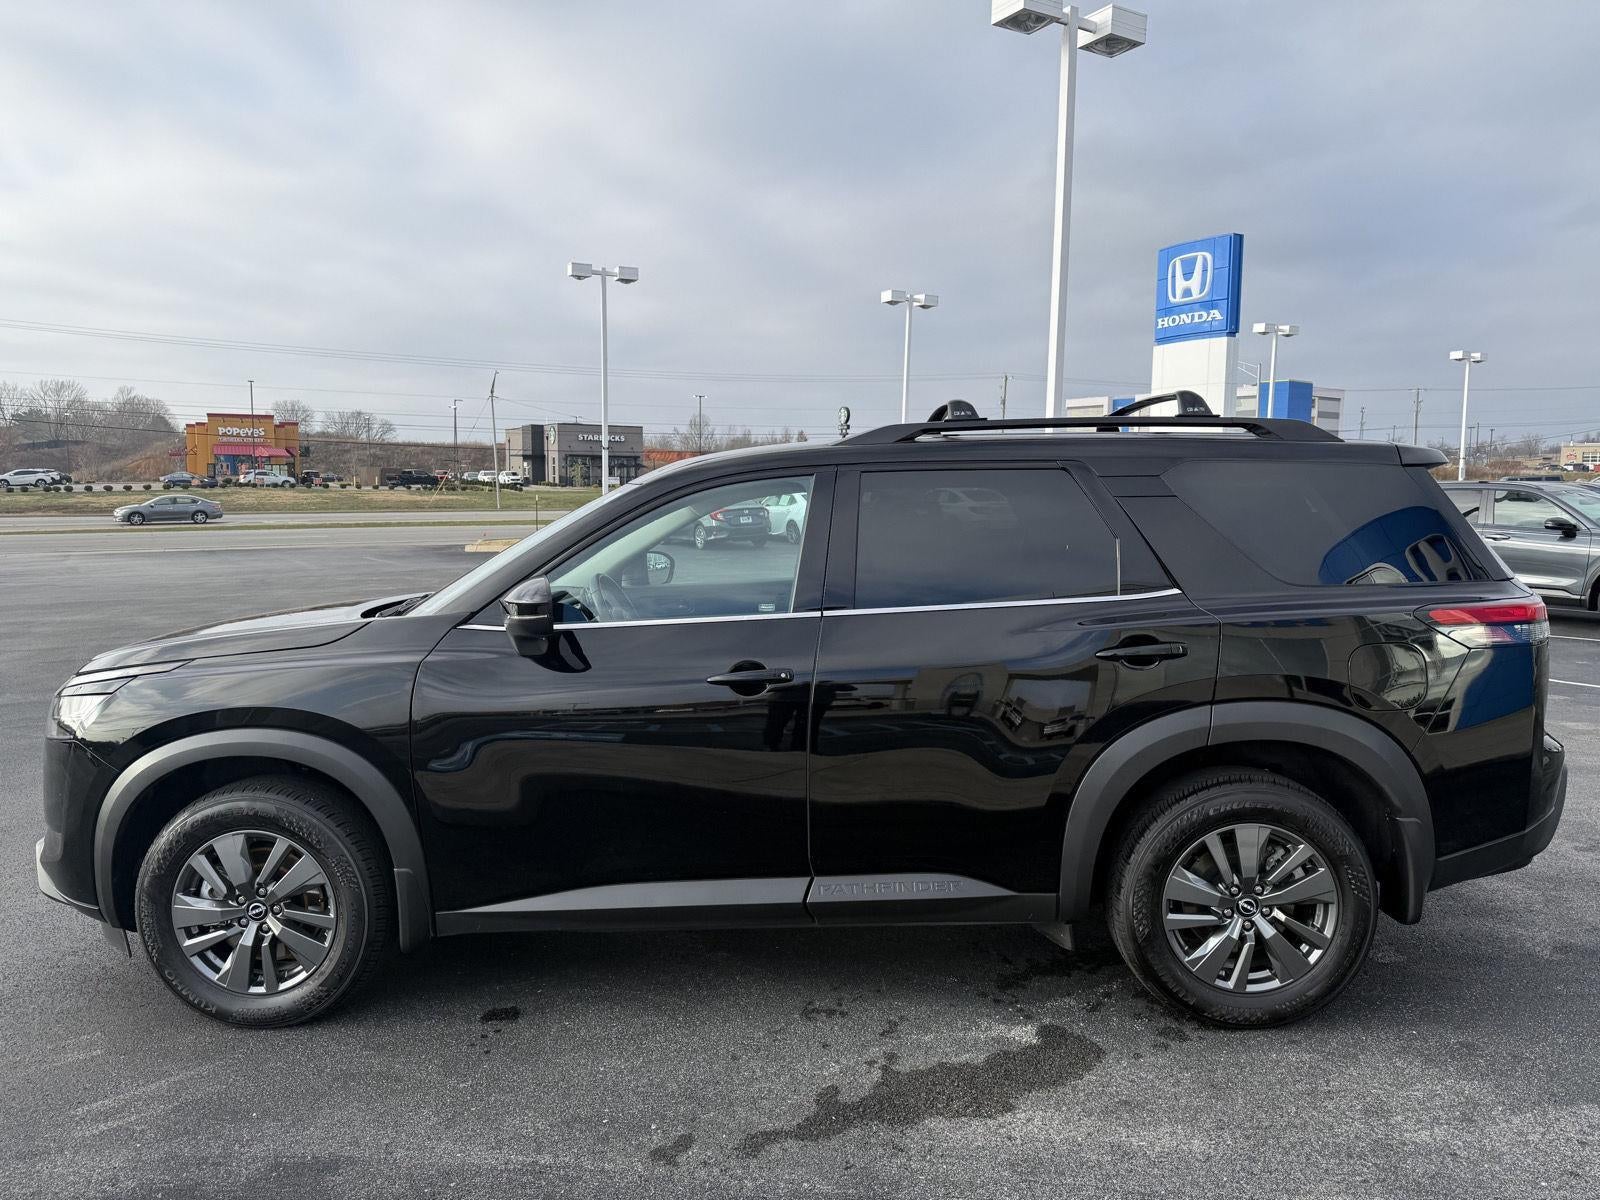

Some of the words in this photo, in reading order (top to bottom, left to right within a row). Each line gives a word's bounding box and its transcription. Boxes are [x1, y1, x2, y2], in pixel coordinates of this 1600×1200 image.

[1156, 309, 1223, 328] HONDA
[578, 434, 625, 442] STARCKS
[817, 880, 963, 896] PATHFINDER
[164, 969, 217, 1014] KUMHO
